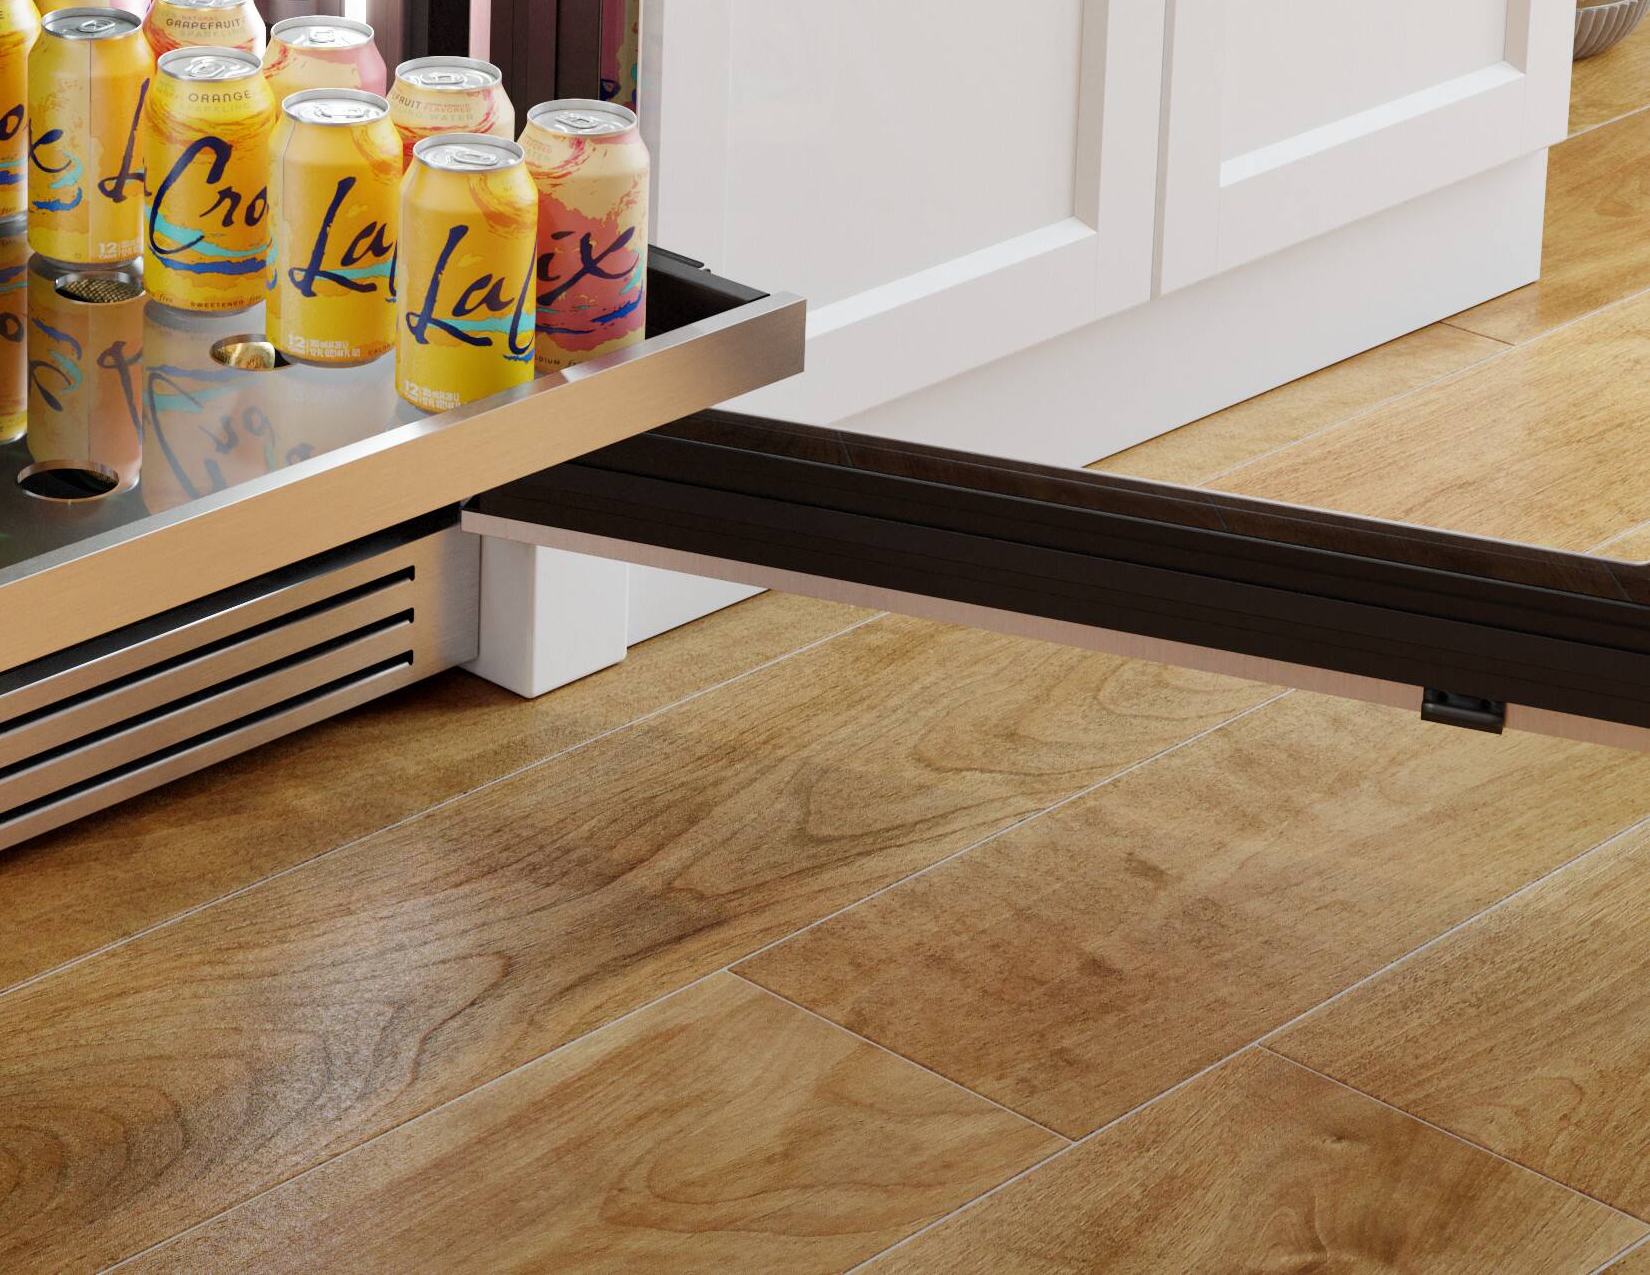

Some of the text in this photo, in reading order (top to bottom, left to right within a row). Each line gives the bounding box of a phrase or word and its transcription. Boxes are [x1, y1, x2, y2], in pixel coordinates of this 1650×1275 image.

[166, 18, 242, 30] GRAPEFRUIT
[188, 90, 253, 103] ORANGE
[99, 241, 117, 254] 12
[190, 300, 244, 308] SWEETENER
